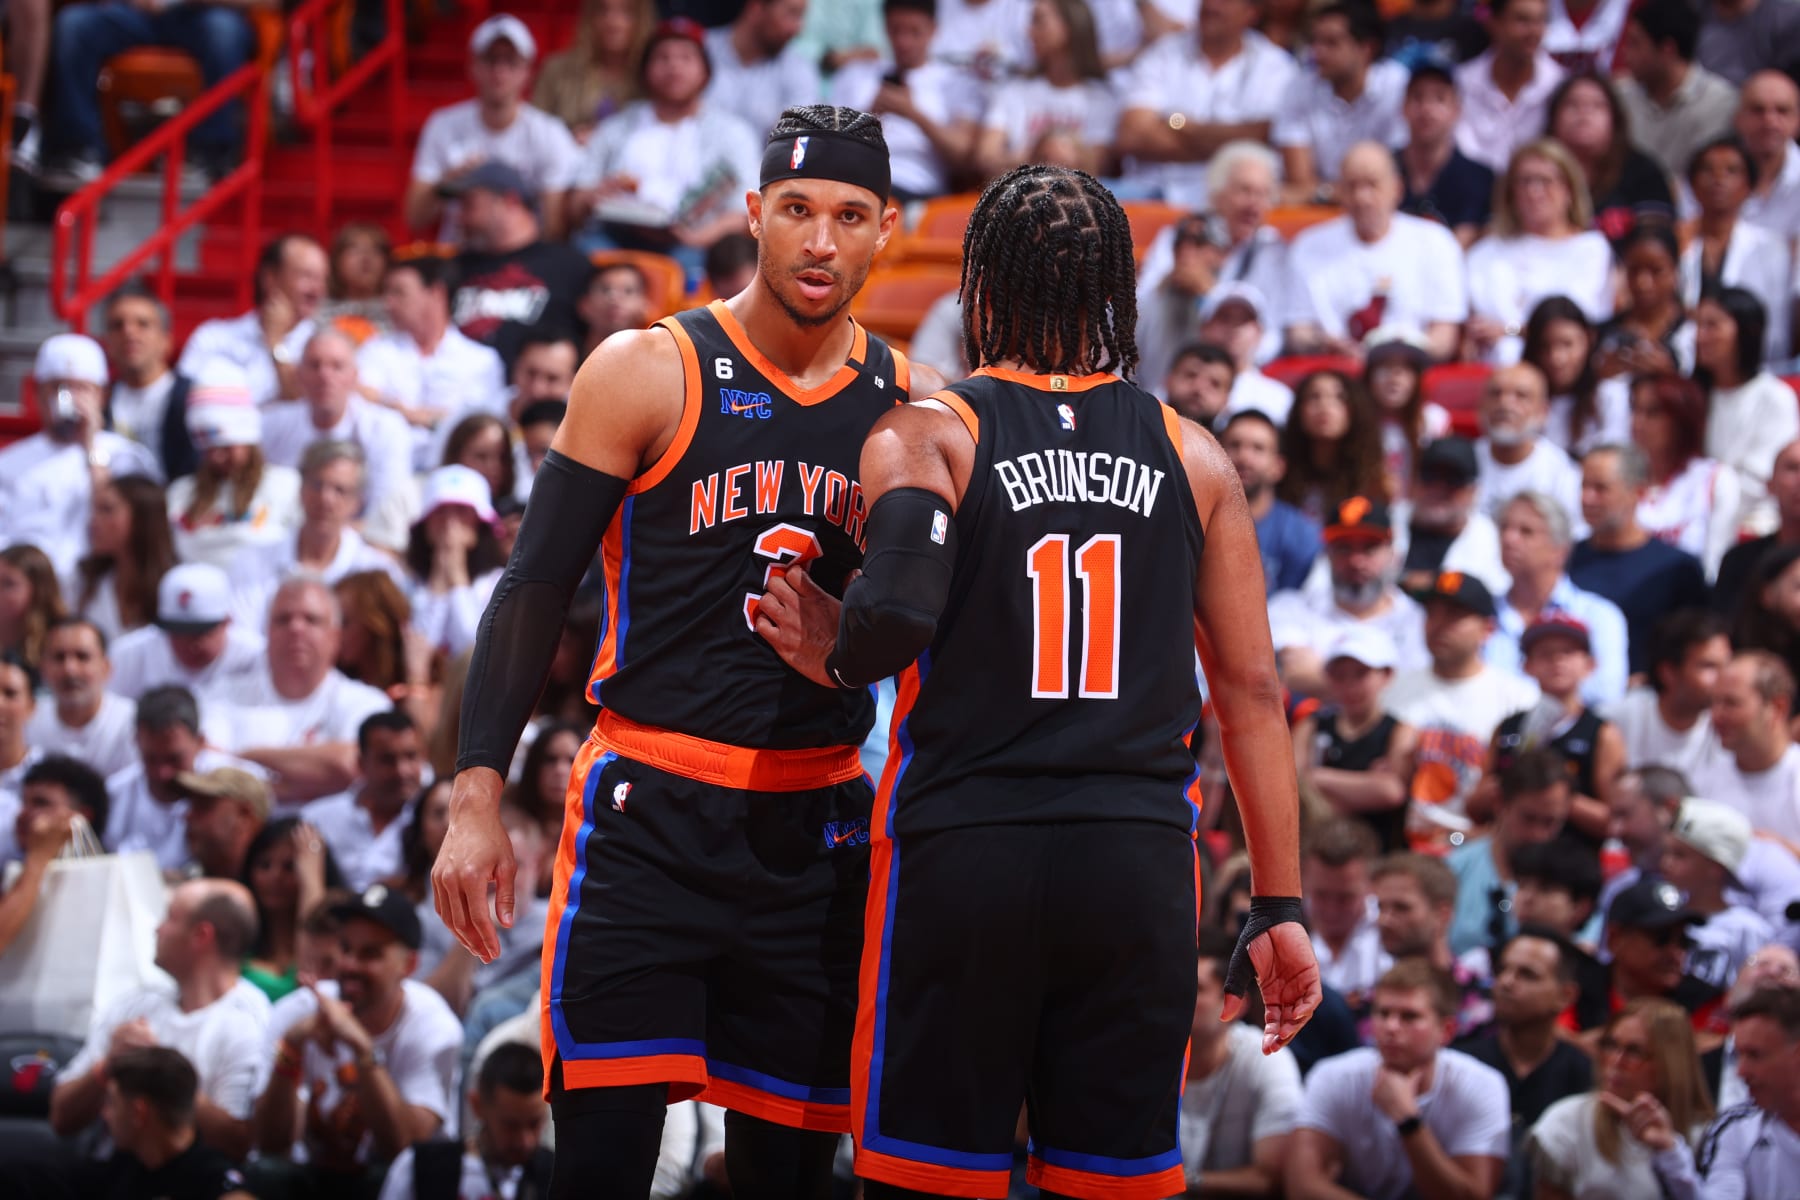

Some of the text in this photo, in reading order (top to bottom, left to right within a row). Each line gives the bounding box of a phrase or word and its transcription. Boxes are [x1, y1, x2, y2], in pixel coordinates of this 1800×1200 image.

[715, 358, 734, 379] 6
[874, 375, 885, 389] 19
[720, 388, 772, 419] NYC
[994, 449, 1165, 517] BRUNSON
[690, 460, 868, 555] NEW YOR
[1026, 533, 1122, 699] 11
[824, 817, 870, 848] NYC
